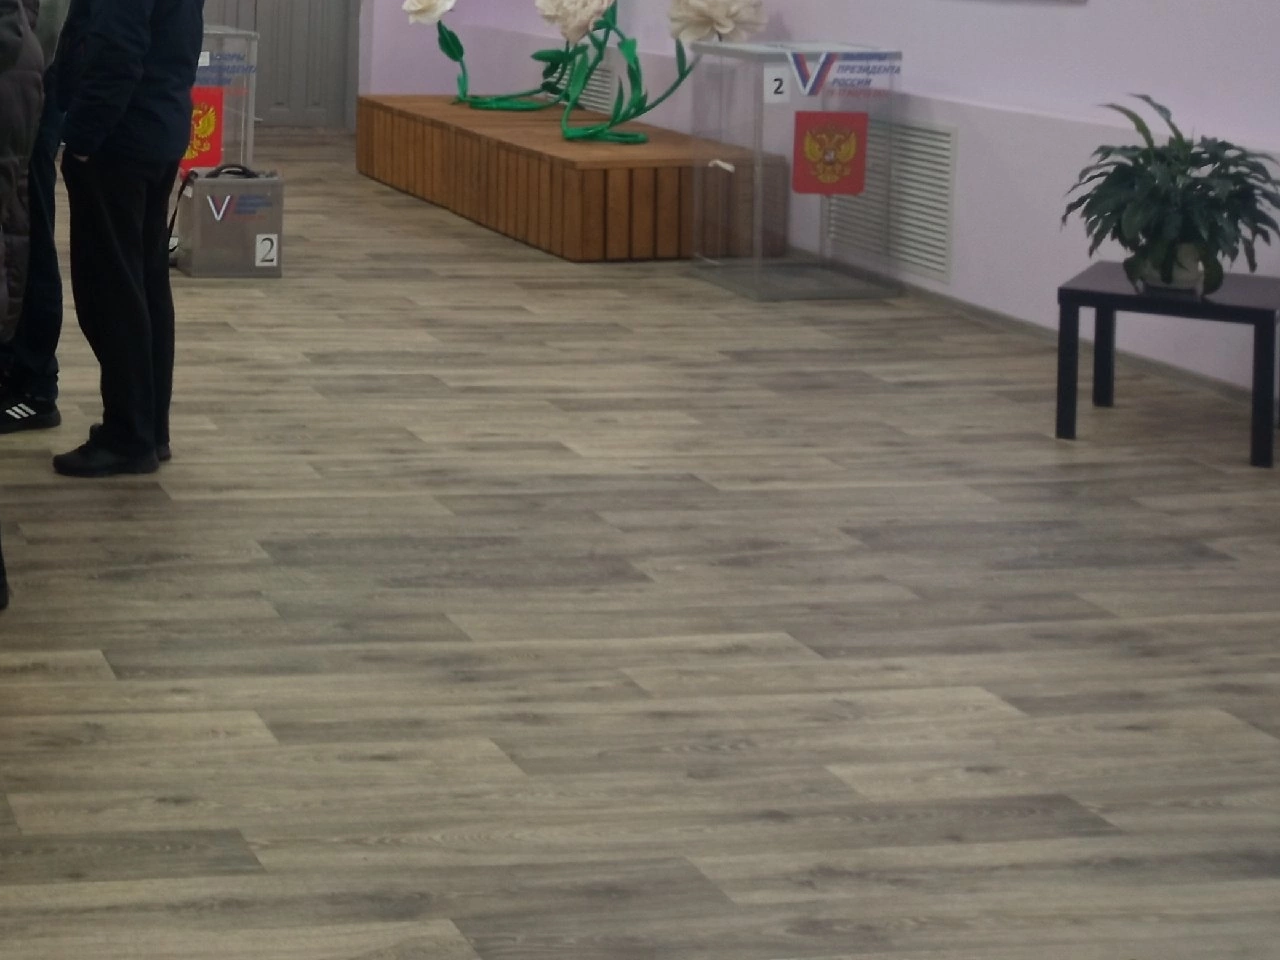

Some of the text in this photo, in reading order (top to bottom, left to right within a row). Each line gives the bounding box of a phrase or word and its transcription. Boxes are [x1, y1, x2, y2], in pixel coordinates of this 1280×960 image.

[836, 65, 901, 75] ПРЕЗИДЕНТА
[773, 78, 784, 95] 2
[831, 78, 872, 88] РОССИИ
[259, 237, 275, 263] 2
